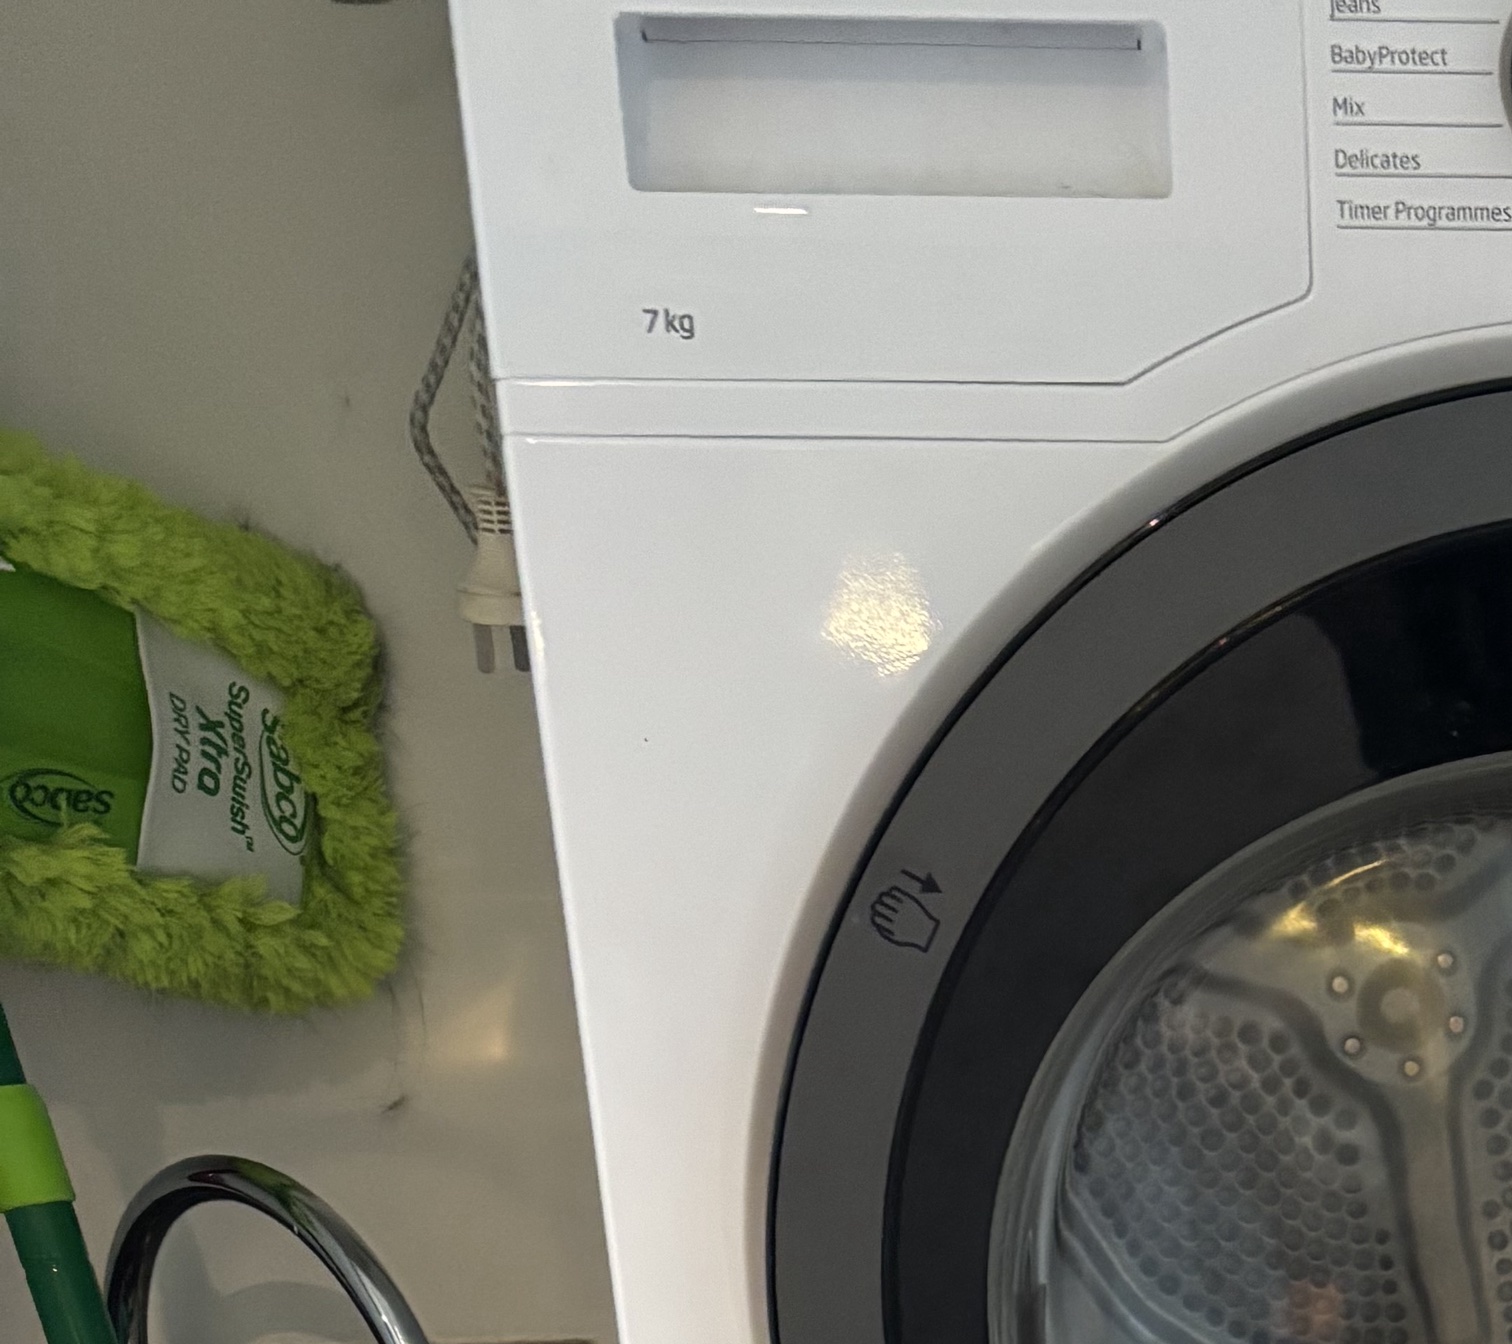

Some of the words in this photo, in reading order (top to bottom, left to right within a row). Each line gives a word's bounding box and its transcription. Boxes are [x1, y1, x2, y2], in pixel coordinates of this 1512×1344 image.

[1331, 44, 1448, 69] BabyProtect
[1332, 97, 1365, 116] Mix
[1334, 149, 1421, 170] Delicates
[1337, 200, 1389, 221] Timer
[1394, 201, 1512, 226] Programmes
[169, 692, 191, 745] DRY
[195, 705, 229, 797] Xtra
[172, 743, 190, 793] PAD
